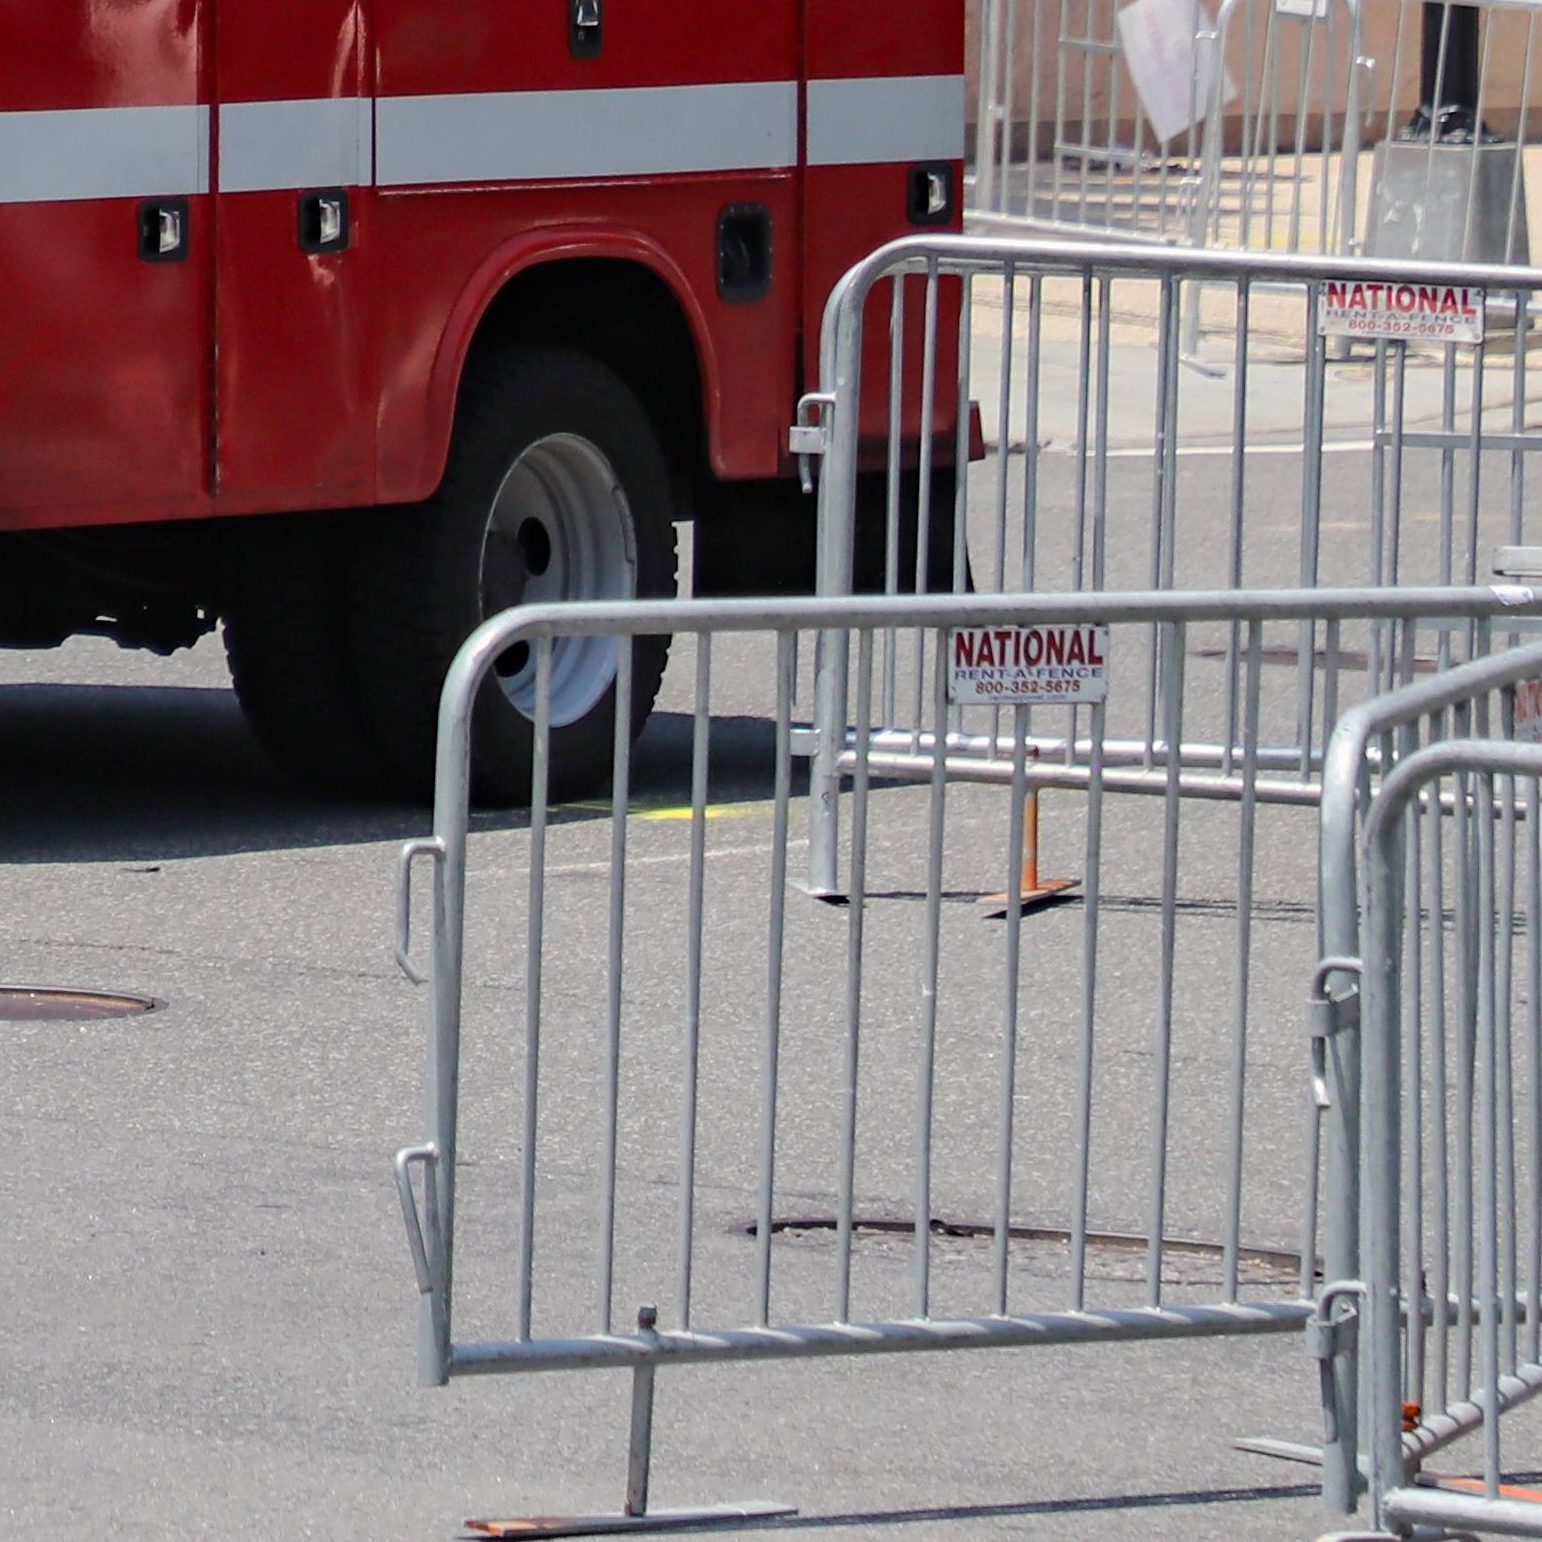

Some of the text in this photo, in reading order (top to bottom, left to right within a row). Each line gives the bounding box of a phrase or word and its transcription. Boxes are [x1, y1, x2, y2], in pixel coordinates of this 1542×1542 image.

[1326, 282, 1476, 316] NATIONAL
[1326, 309, 1476, 324] RENT-A-FENCE
[955, 629, 1104, 667] NATIONAL
[954, 667, 1104, 680] RENT-A-FENCE
[975, 680, 1081, 694] 800-352-5675
